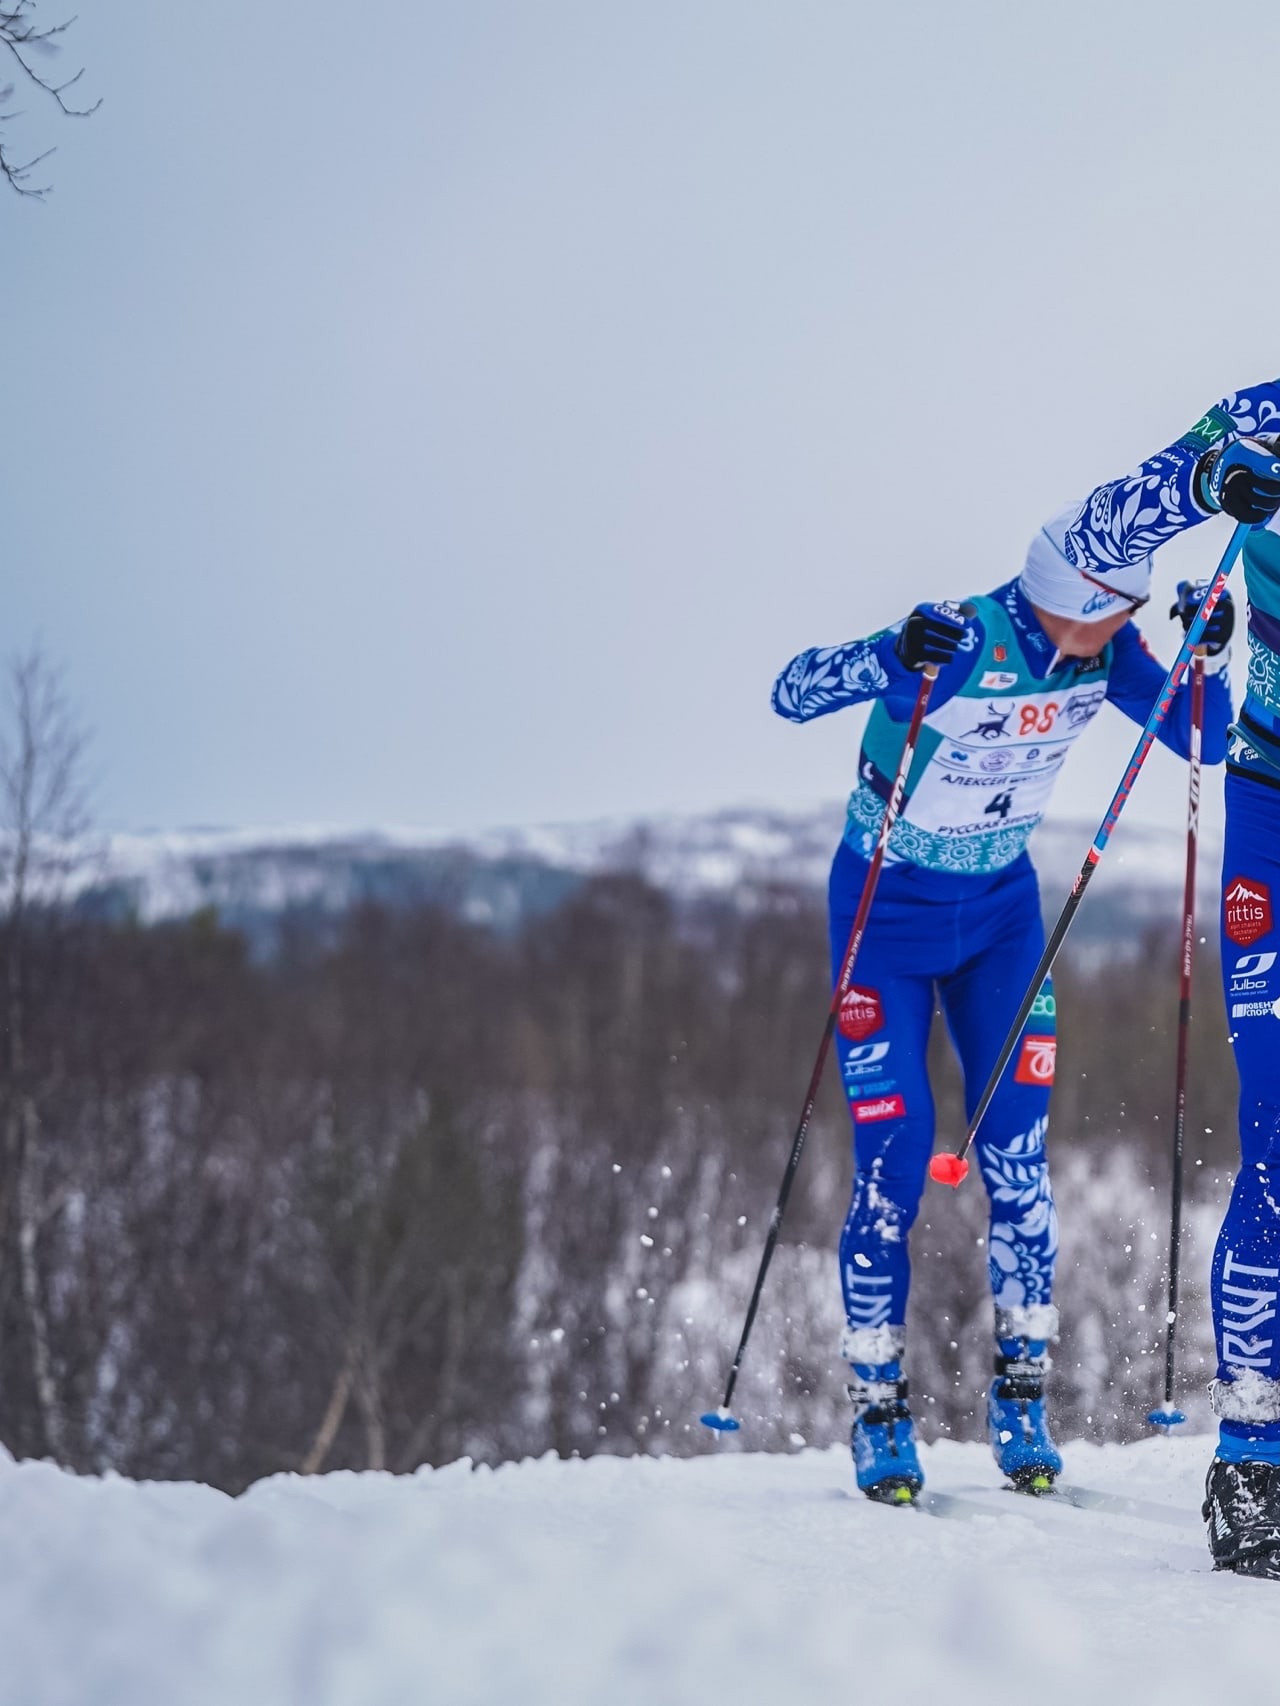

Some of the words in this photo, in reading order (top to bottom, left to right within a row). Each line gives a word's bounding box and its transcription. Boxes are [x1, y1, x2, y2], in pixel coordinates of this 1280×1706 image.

[933, 603, 966, 625] COXA
[984, 786, 1017, 818] 4
[1228, 904, 1264, 923] rittis
[1229, 978, 1267, 991] Julbo
[840, 1006, 876, 1022] rittis
[1246, 1001, 1274, 1010] ЮВЕНТ
